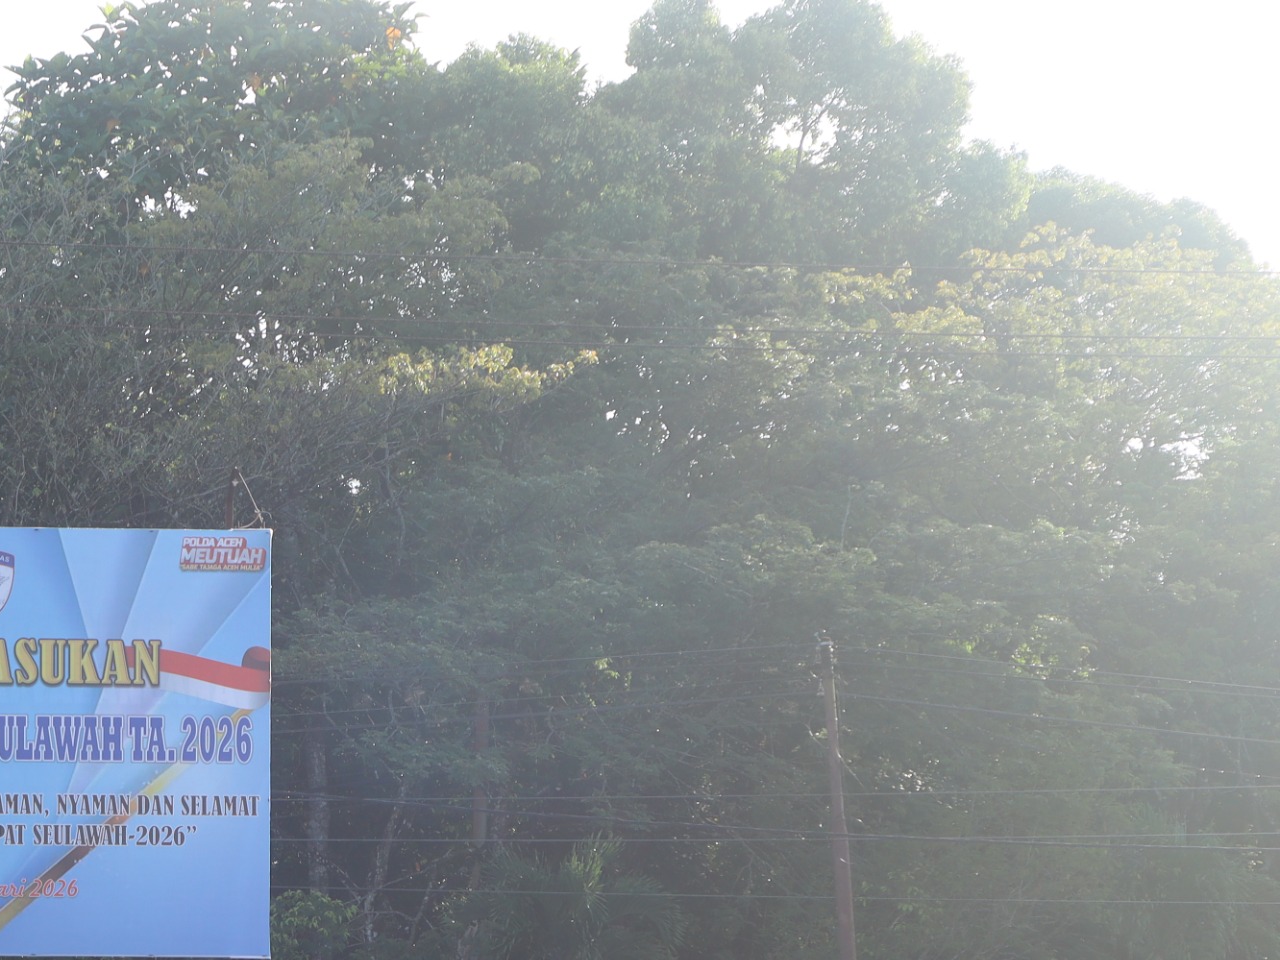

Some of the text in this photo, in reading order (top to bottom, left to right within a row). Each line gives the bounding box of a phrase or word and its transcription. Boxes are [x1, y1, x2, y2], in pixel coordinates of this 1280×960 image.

[183, 537, 243, 547] POLDA ACEH
[181, 548, 263, 564] MEUTUAH
[128, 714, 176, 763] TA.
[180, 714, 254, 764] 2026
[57, 793, 131, 817] NYAMAN
[137, 794, 174, 817] DAN
[181, 795, 260, 818] SELAMAT
[30, 878, 79, 898] 2026
